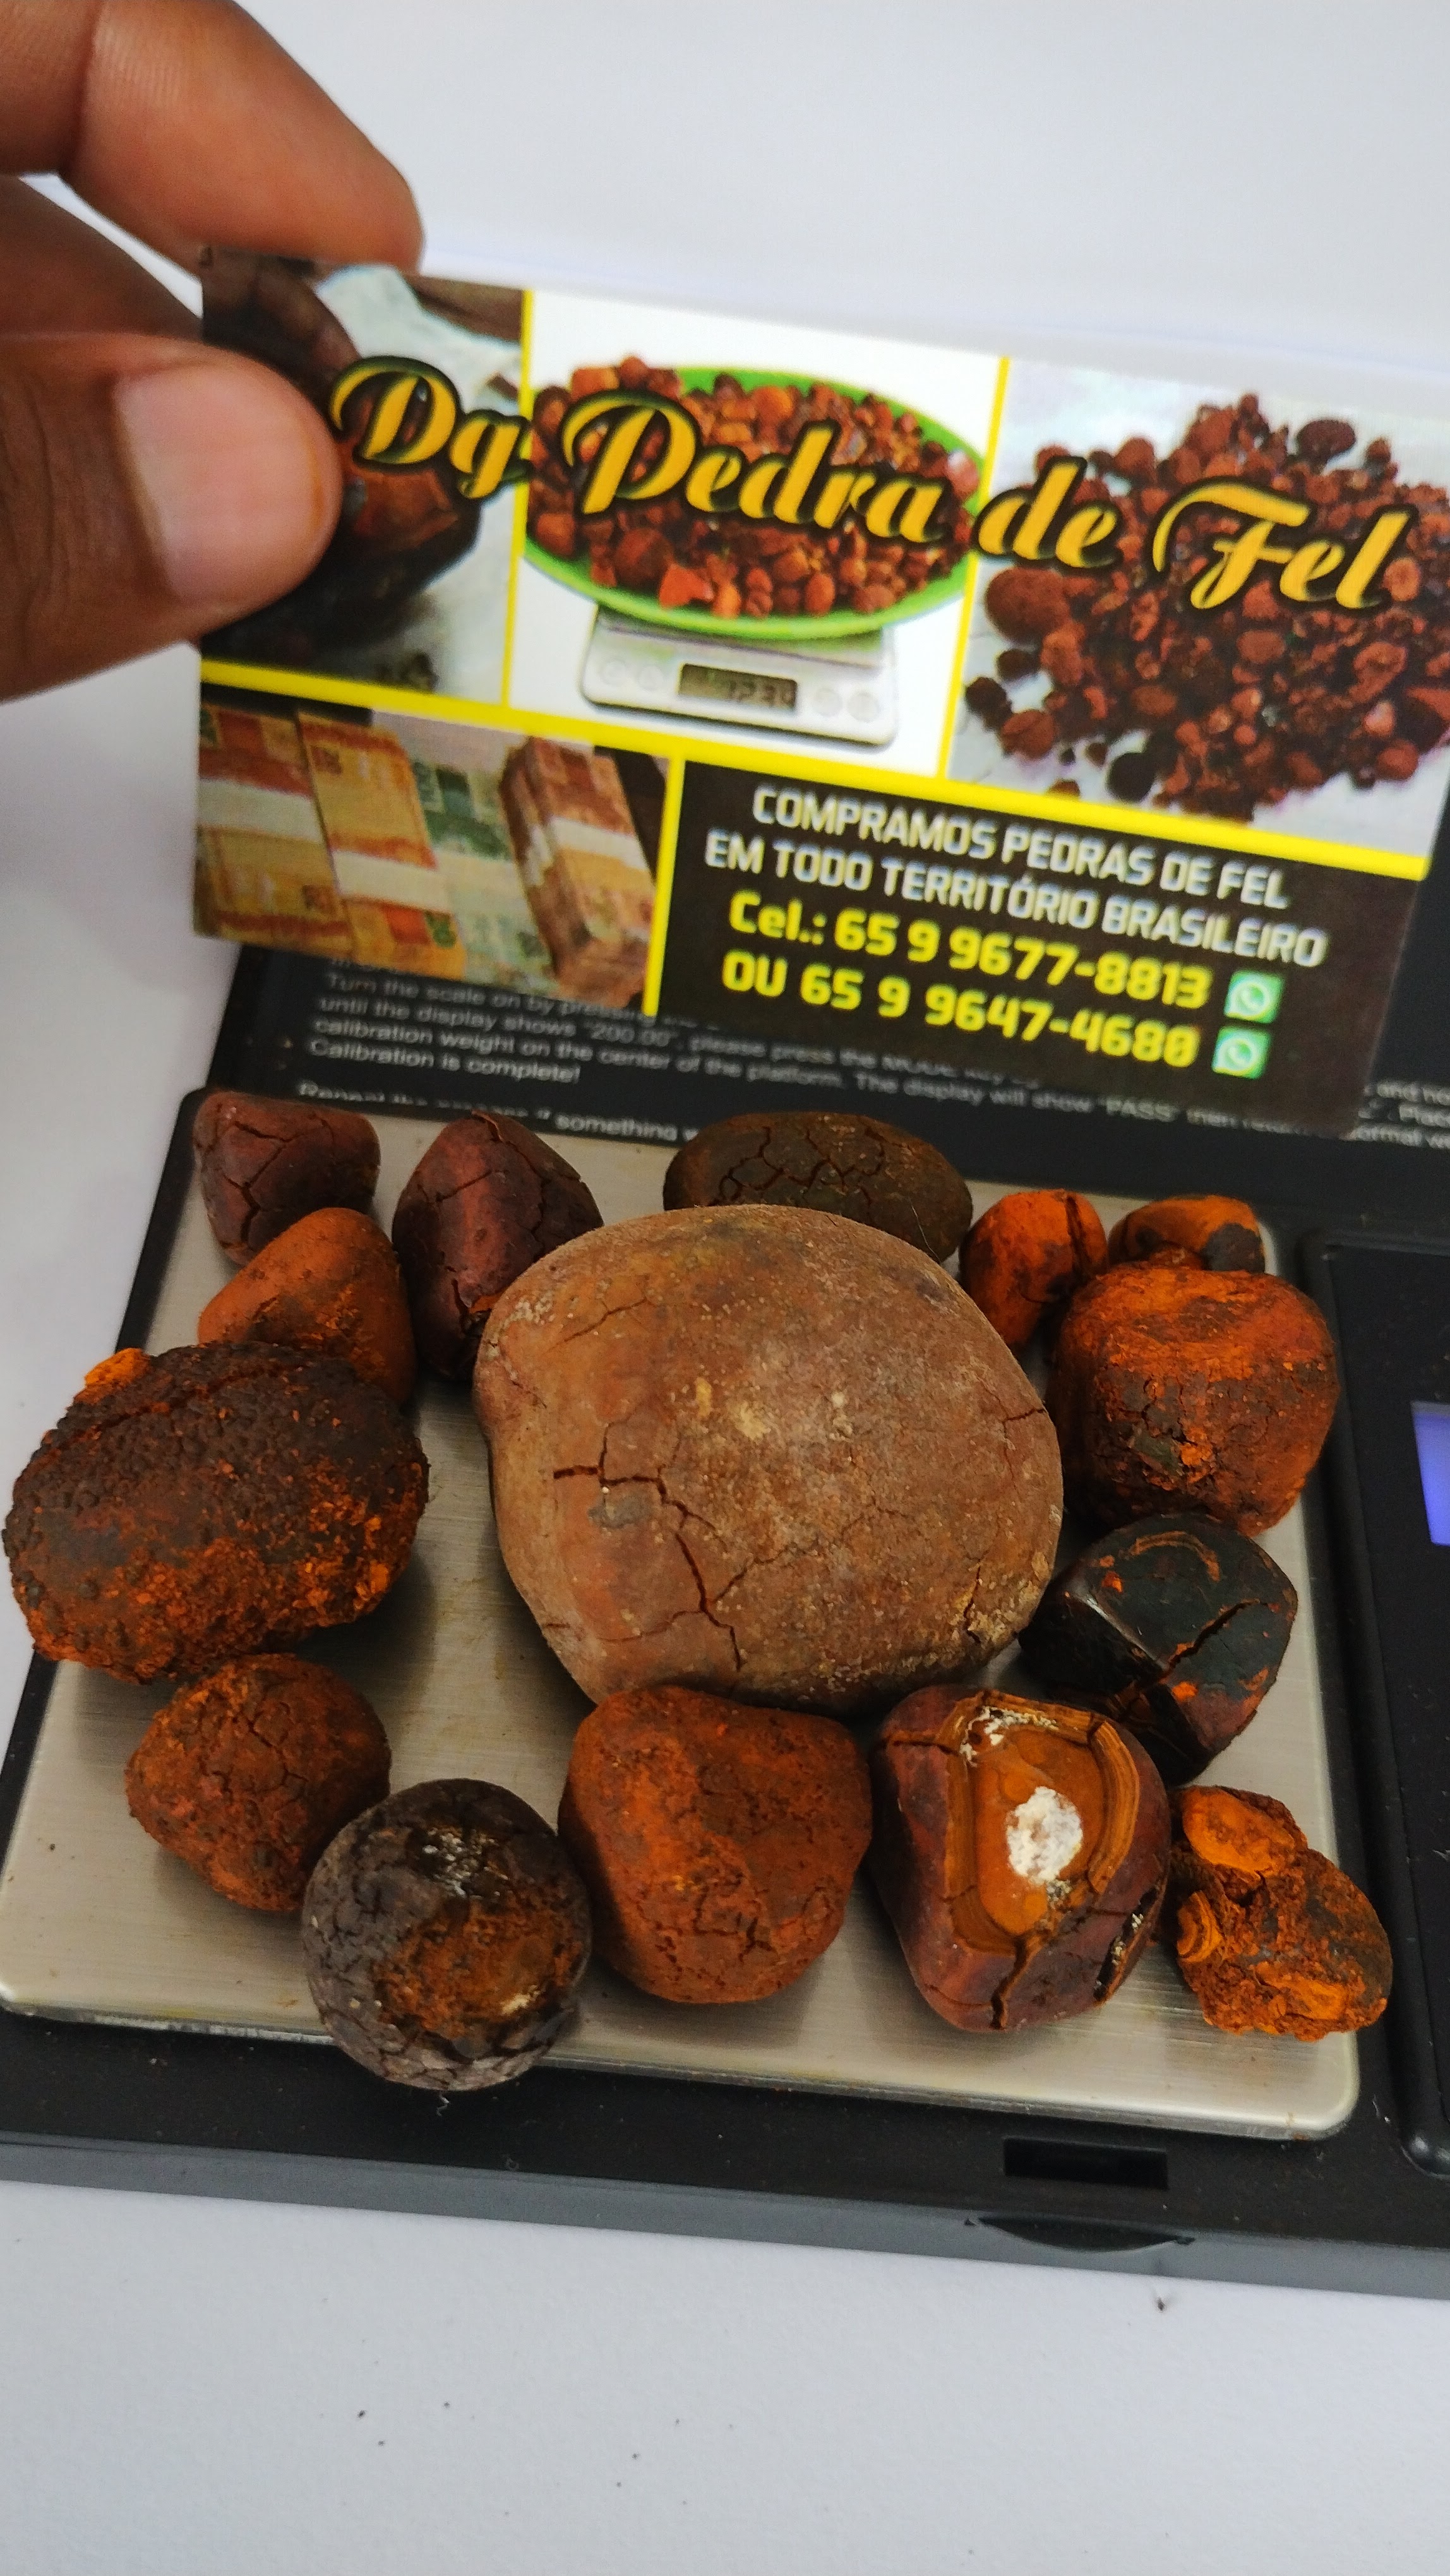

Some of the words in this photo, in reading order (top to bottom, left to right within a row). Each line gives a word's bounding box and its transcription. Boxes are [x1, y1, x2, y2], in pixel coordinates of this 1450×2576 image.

[562, 393, 945, 544] Pedra
[979, 462, 1119, 568] de
[1152, 479, 1411, 610] Fel
[752, 784, 998, 861] COMPRAMOS
[1001, 823, 1156, 886] PEDRAS
[1159, 850, 1214, 897] DE
[1216, 859, 1290, 910] FEL
[705, 828, 765, 874] EM
[772, 839, 873, 891] TODO
[881, 856, 1101, 929] TERRITÓRIO
[1101, 893, 1327, 969] BRASILEIRO
[381, 979, 420, 999] the
[722, 948, 789, 998] OU
[800, 962, 865, 1011] 65
[877, 975, 911, 1018] 9
[728, 889, 827, 946] Cel.:
[834, 907, 900, 957] 65
[906, 918, 942, 963] 9
[949, 925, 1214, 1010] 9677-8813
[309, 1037, 435, 1067] Calibration
[440, 1051, 462, 1072] is
[315, 1018, 434, 1044] calibration
[440, 1032, 515, 1056] weight
[520, 1042, 551, 1057] on
[555, 1041, 594, 1062] the
[598, 1049, 671, 1070] center
[674, 1054, 702, 1073] of
[704, 1058, 743, 1078] the
[854, 1071, 899, 1094] The
[902, 1078, 984, 1106] display
[988, 1087, 1026, 1106] will
[1031, 1093, 1093, 1113] show
[319, 996, 369, 1015] until
[374, 1002, 410, 1021] the
[416, 1007, 498, 1032] display
[504, 1014, 577, 1037] shows
[688, 1035, 767, 1059] please
[770, 1045, 836, 1065] press
[839, 1048, 878, 1070] the
